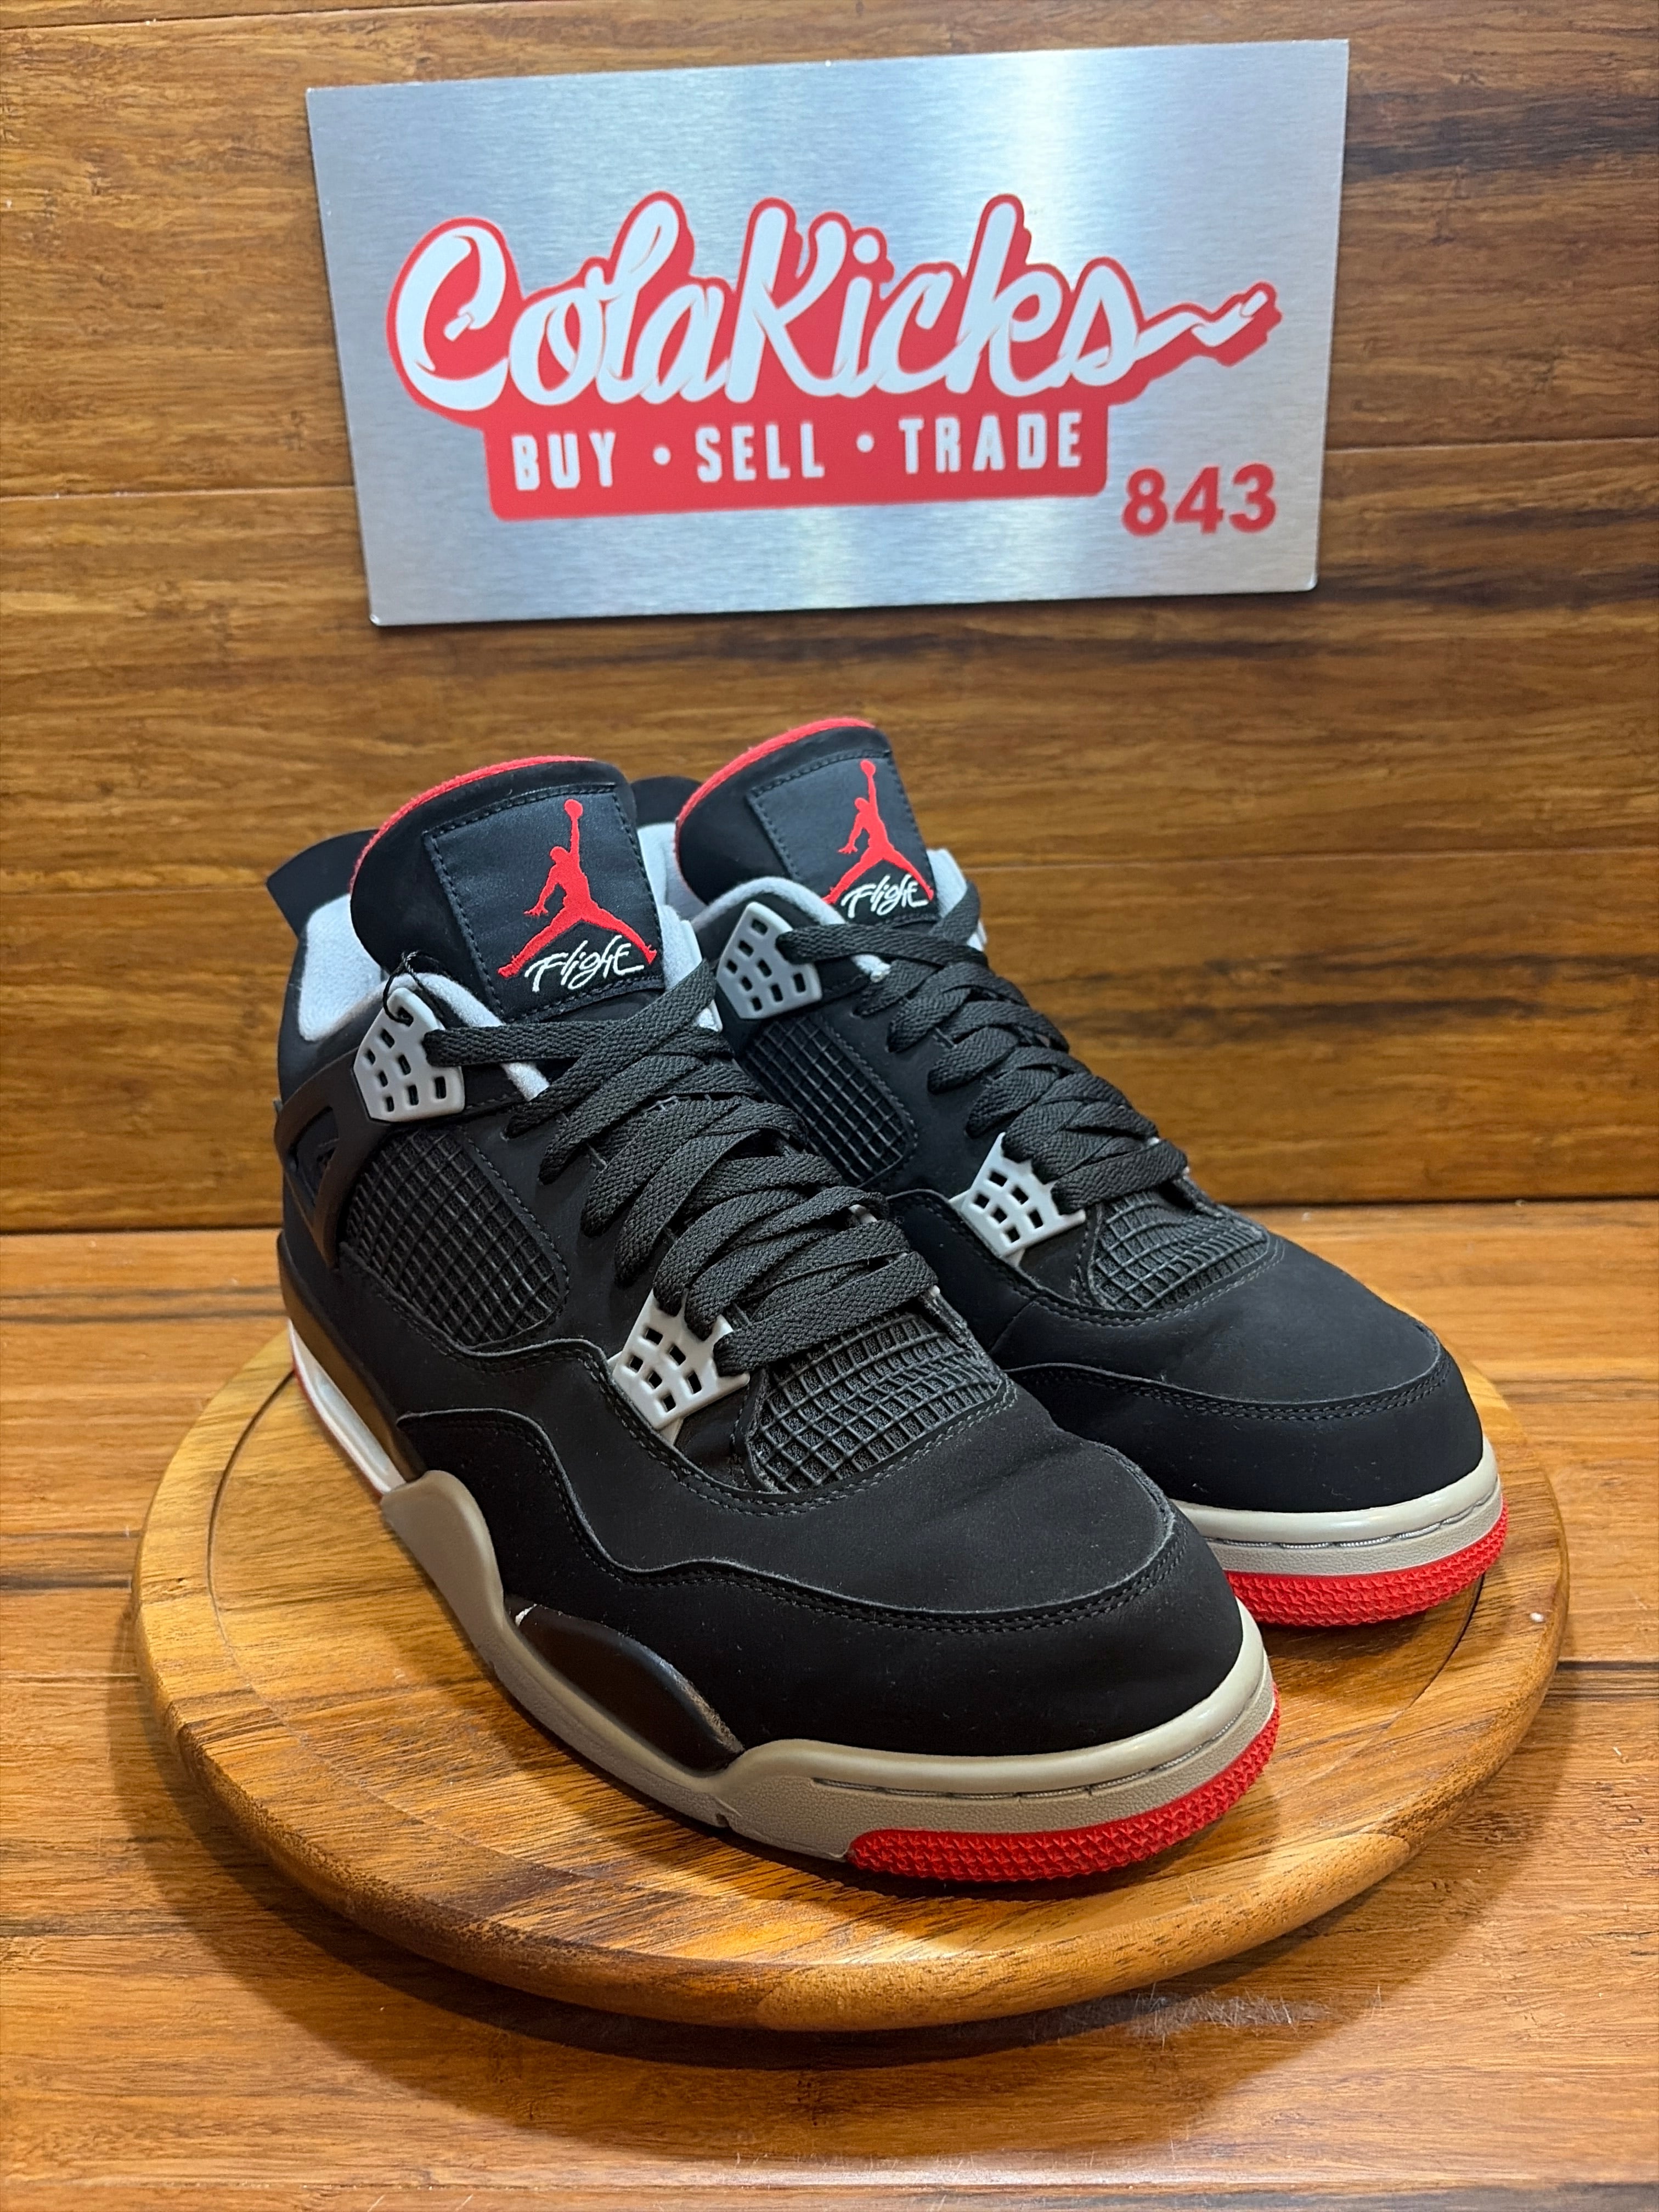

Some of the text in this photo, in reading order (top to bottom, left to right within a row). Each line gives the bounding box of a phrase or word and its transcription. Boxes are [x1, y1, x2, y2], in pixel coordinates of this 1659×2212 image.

[397, 196, 1268, 413] ColaKicks
[511, 410, 1082, 492] BUY SELL TRADE
[1122, 462, 1277, 537] 843
[840, 872, 929, 918] Flight
[523, 933, 645, 992] Flight
